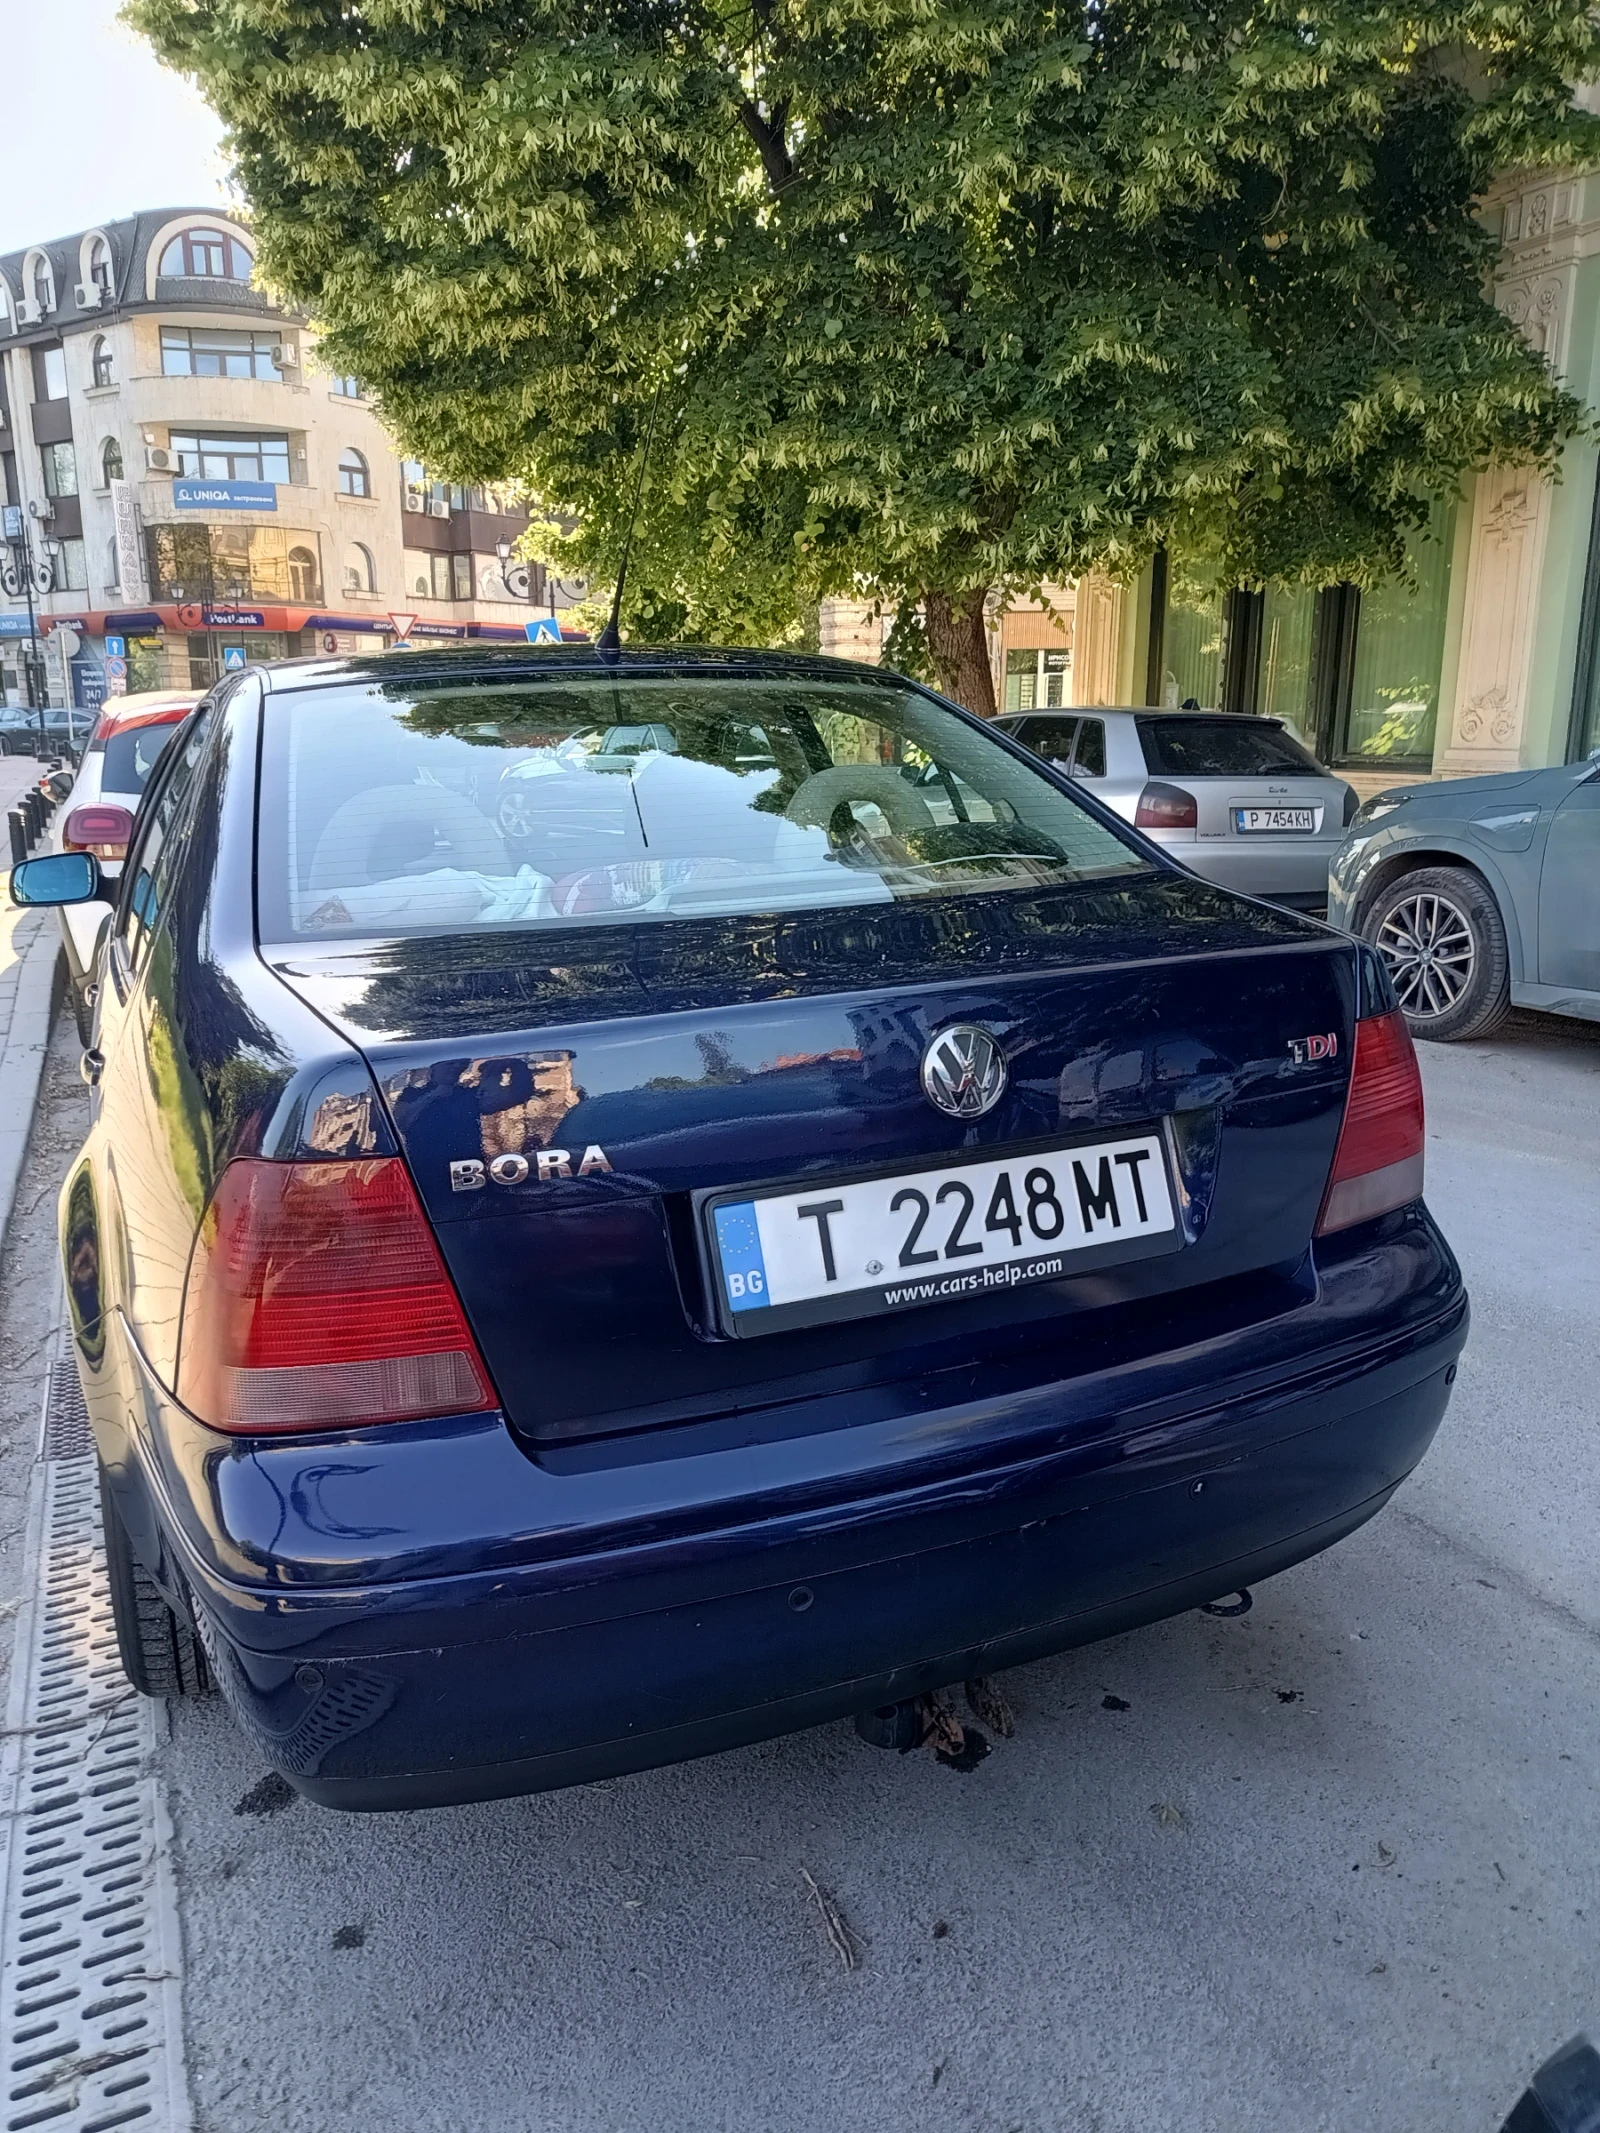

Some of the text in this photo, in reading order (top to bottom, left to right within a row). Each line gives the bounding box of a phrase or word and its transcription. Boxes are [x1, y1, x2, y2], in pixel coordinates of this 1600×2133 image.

[193, 490, 231, 501] UNIQA
[85, 689, 102, 700] 24/7
[1250, 811, 1259, 827] P
[1265, 811, 1294, 828] 7454
[1294, 811, 1311, 827] KH
[1287, 1032, 1337, 1064] TDI
[449, 1144, 614, 1192] BORA
[728, 1149, 1151, 1298] BG T 2248 MT
[884, 1256, 1063, 1306] www.cars-help.com
